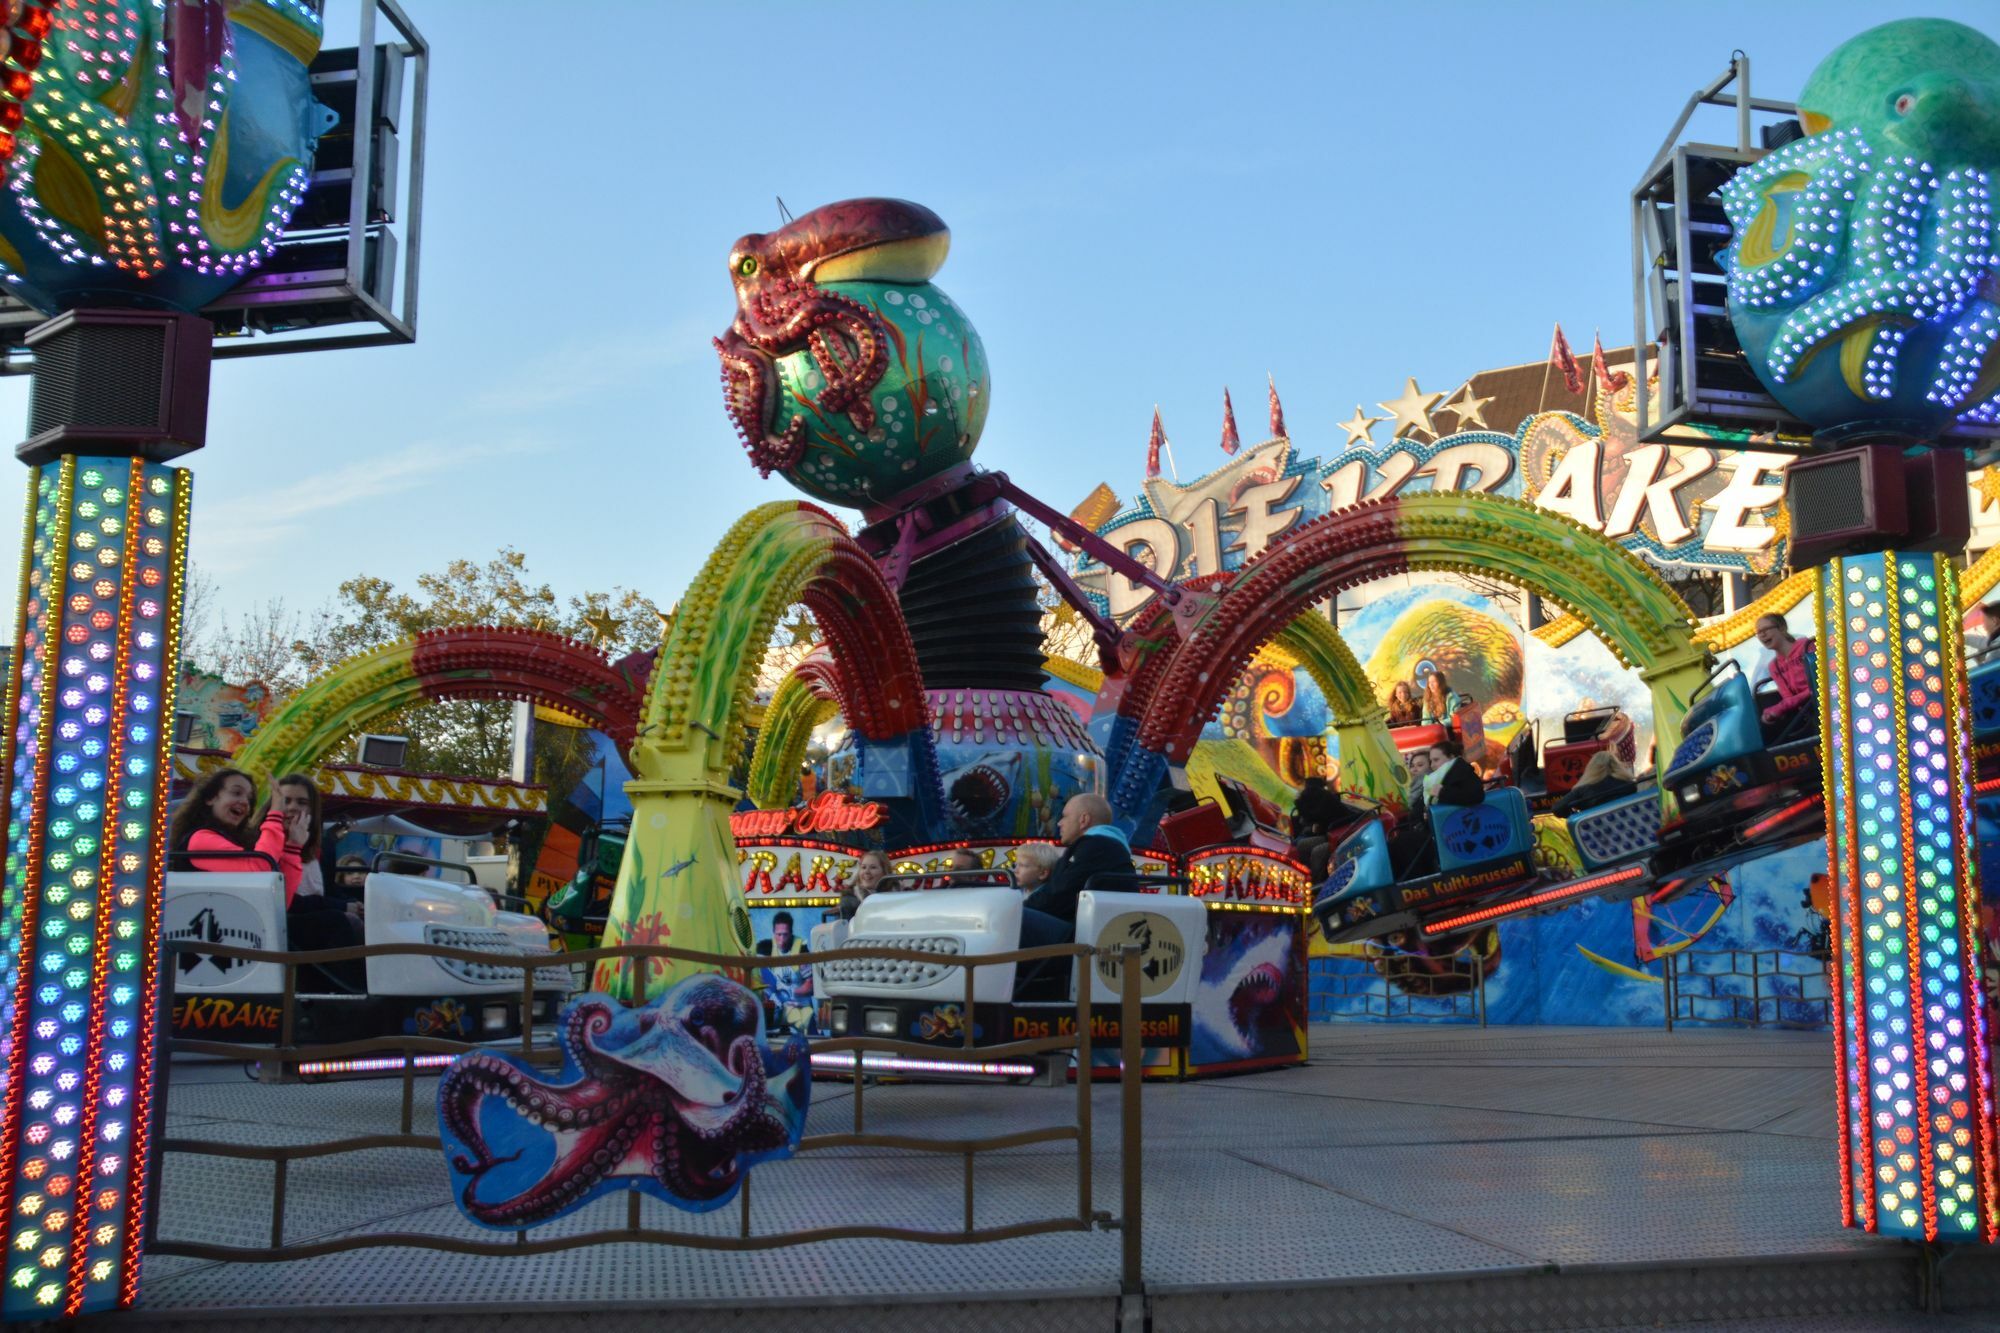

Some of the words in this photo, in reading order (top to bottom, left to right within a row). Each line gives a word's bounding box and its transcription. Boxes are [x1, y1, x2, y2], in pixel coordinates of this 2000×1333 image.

[1101, 474, 1304, 616] DIE
[1774, 752, 1809, 772] Das
[737, 849, 858, 895] RAKE
[1401, 888, 1429, 903] Das
[1433, 861, 1525, 895] Kultkarussell
[180, 997, 284, 1030] KRAKE
[1013, 1016, 1049, 1039] Das
[1057, 1014, 1180, 1038] Ktkassell
